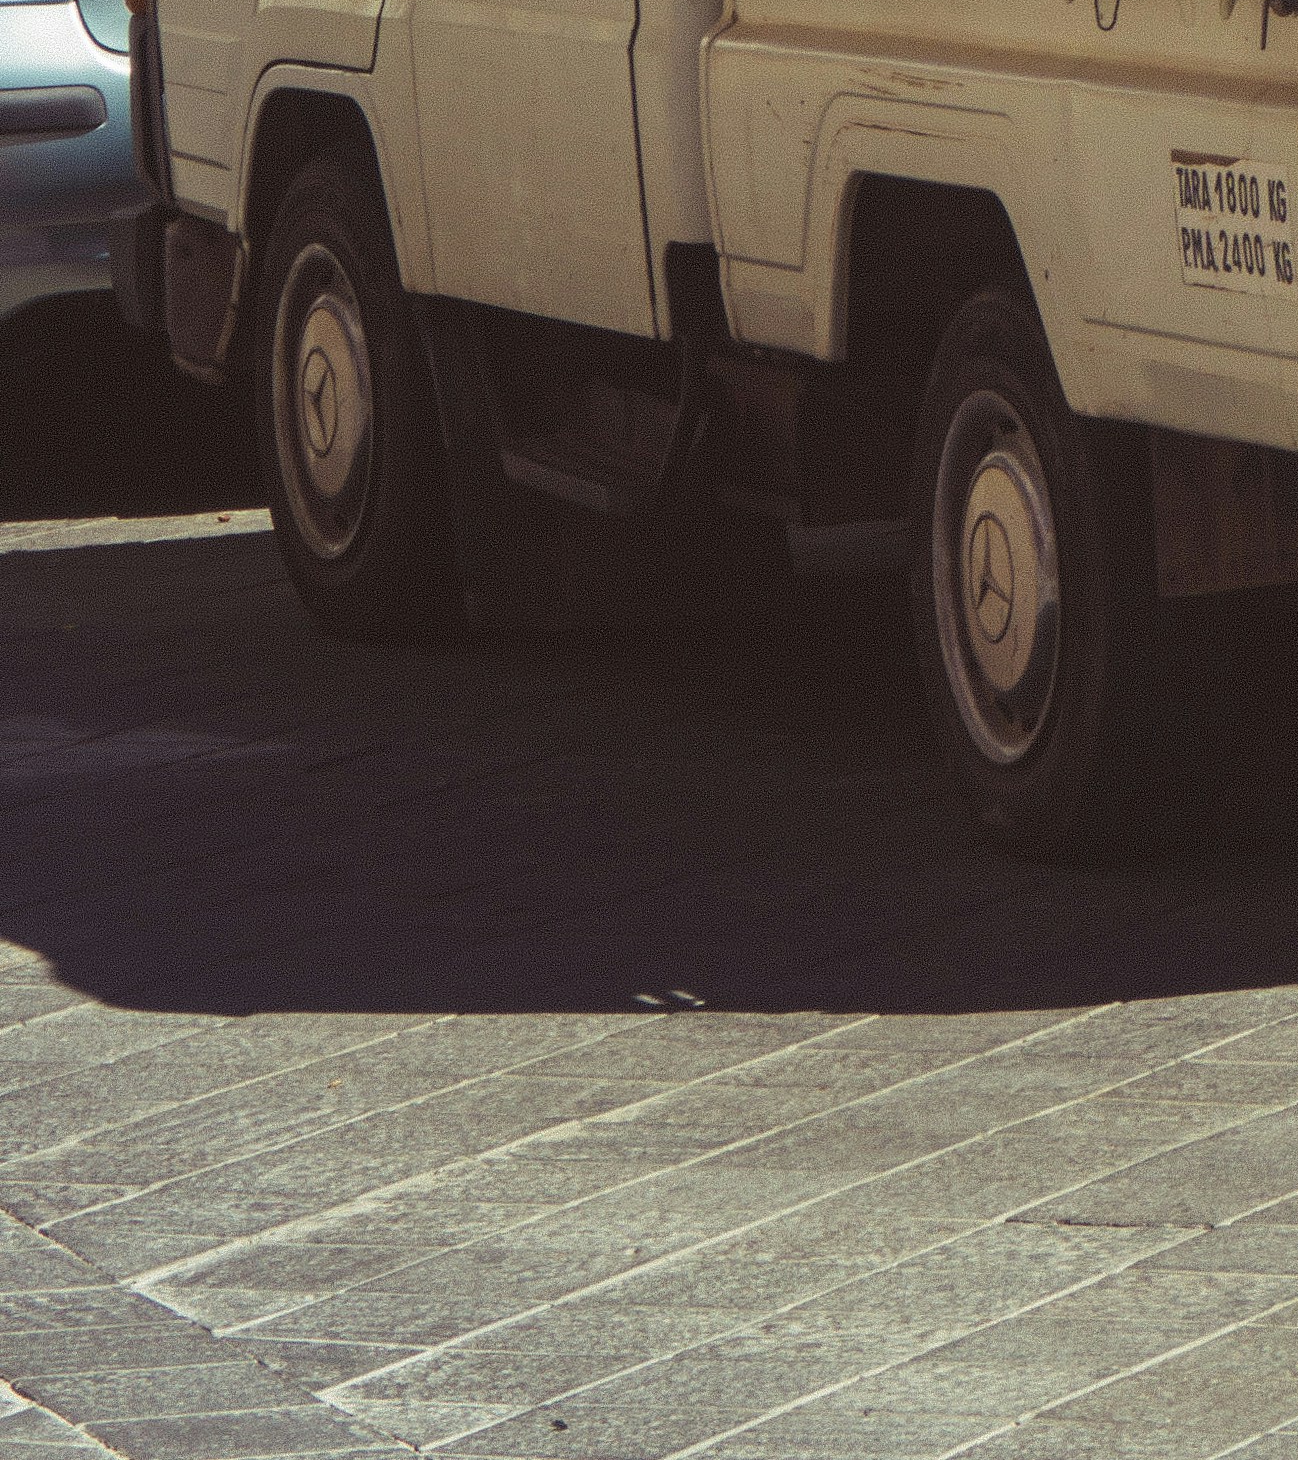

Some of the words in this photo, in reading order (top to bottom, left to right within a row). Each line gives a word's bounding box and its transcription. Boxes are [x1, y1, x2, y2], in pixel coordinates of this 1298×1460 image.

[1175, 167, 1212, 213] TARA
[1214, 171, 1260, 220] 1800
[1267, 179, 1288, 223] KG
[1219, 230, 1266, 277] 2400
[1272, 239, 1294, 285] KG
